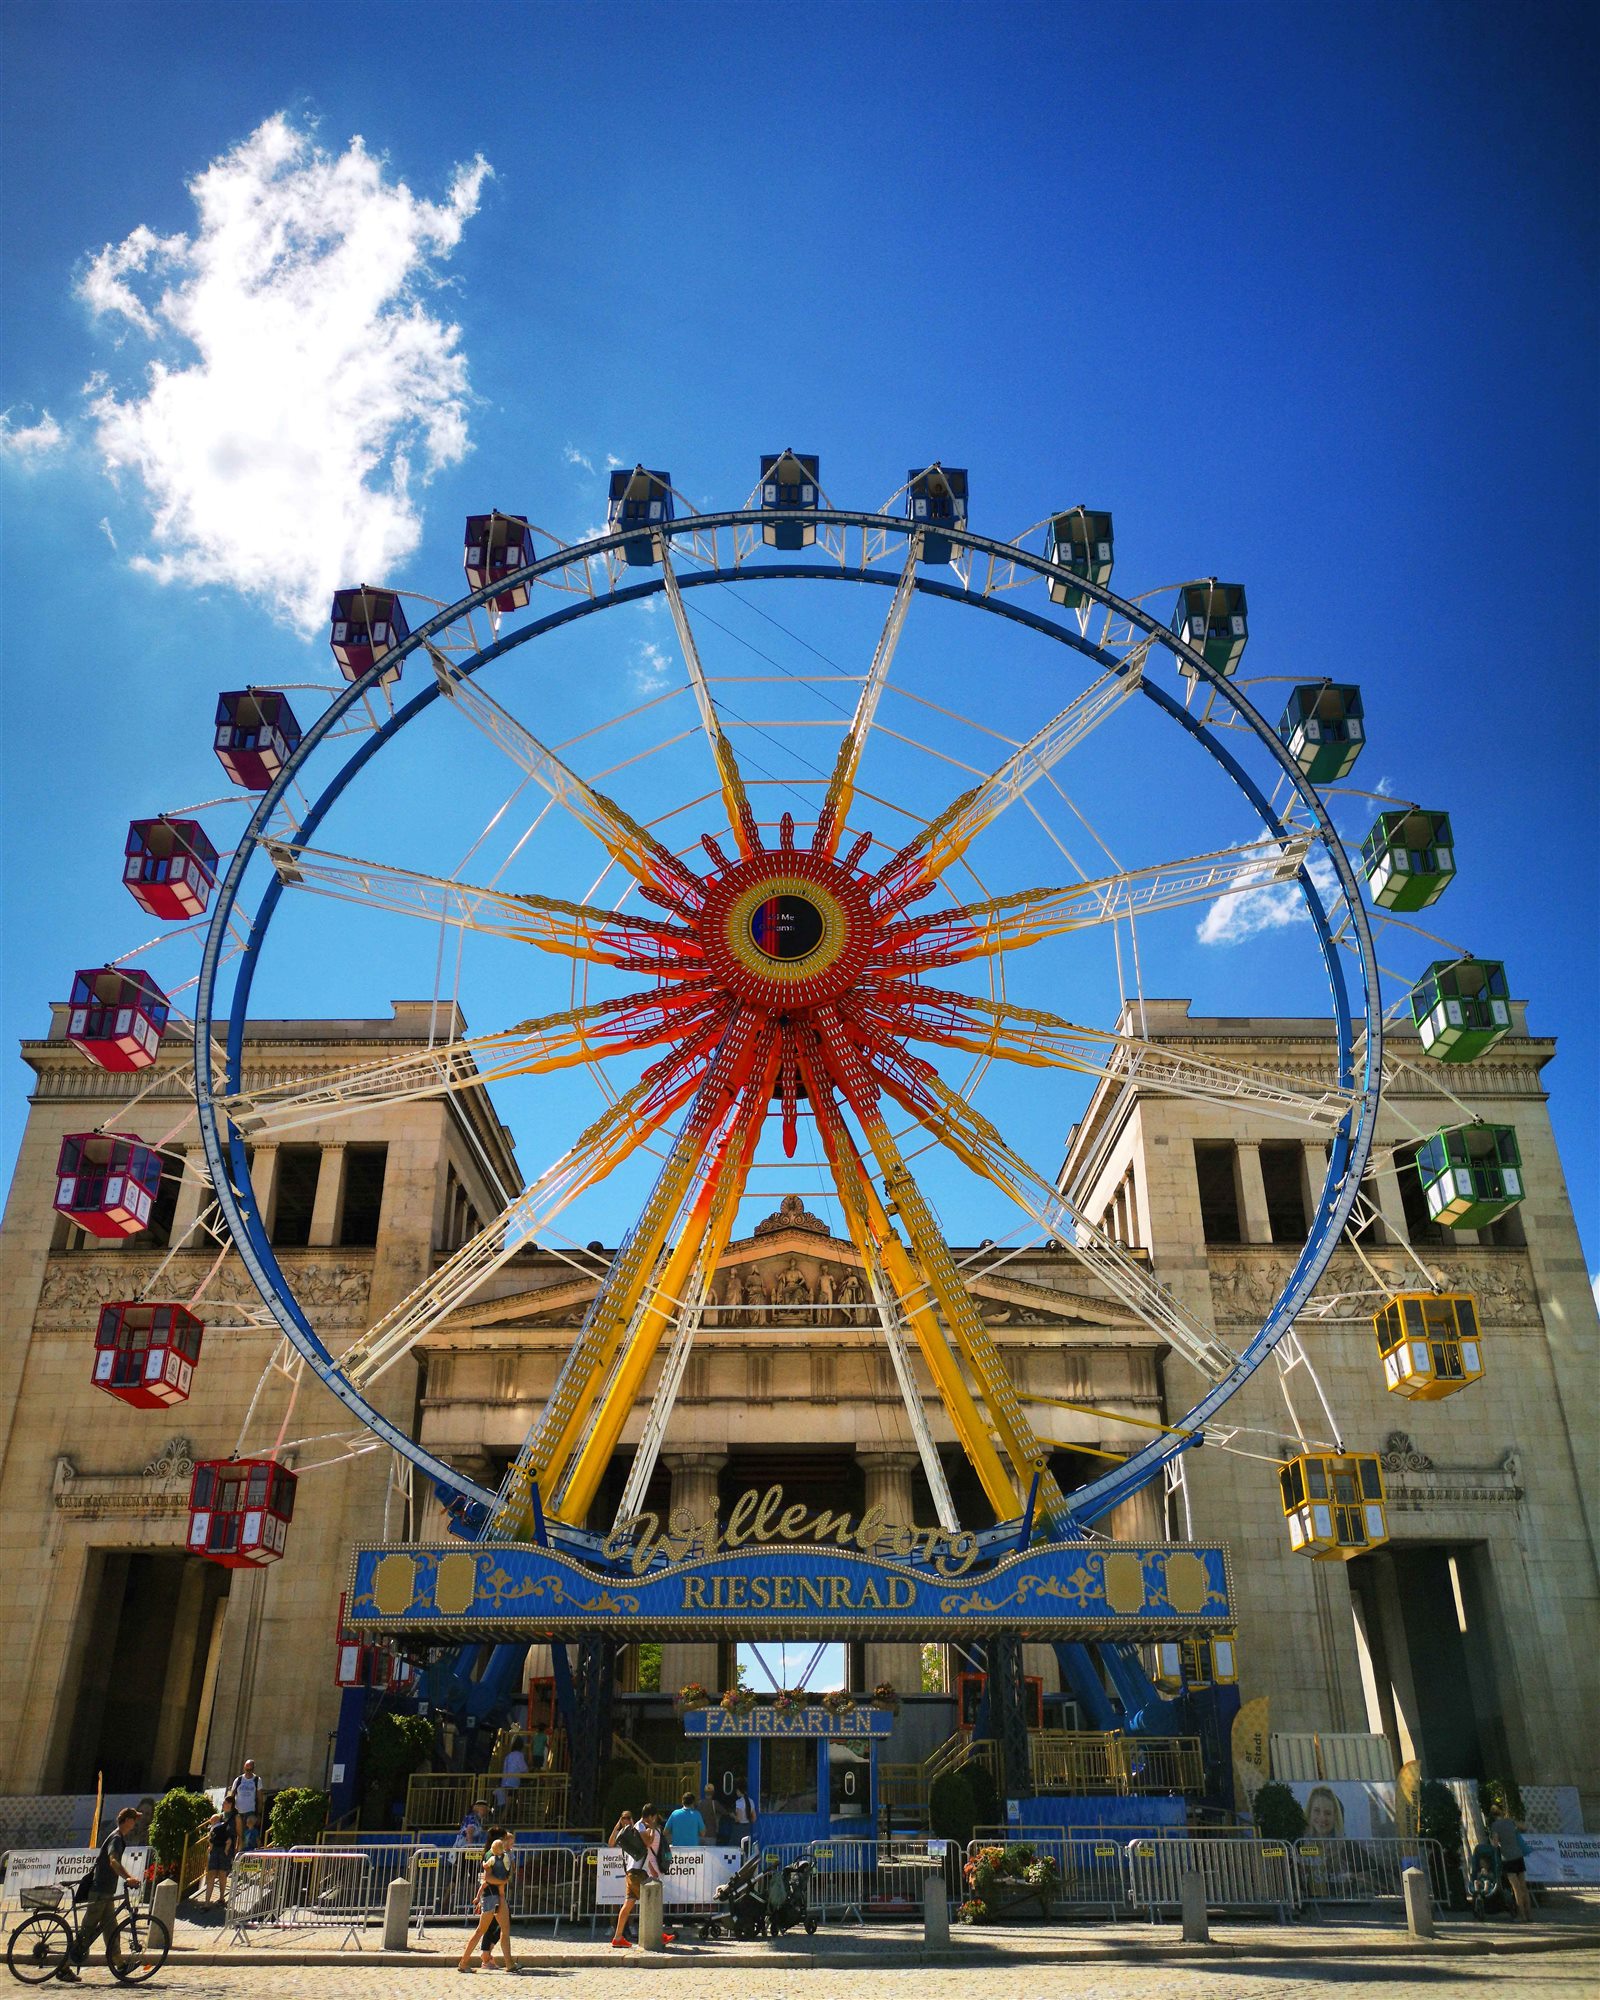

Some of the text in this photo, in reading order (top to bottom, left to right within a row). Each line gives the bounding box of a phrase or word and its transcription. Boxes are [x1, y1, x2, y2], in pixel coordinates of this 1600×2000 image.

[602, 1484, 979, 1576] Willenborg
[681, 1576, 917, 1610] RIESENRAD
[706, 1711, 871, 1732] FAHRKARTEN
[1253, 1732, 1262, 1767] Stadt
[1558, 1839, 1600, 1849] Kunstarea
[670, 1854, 704, 1865] stareal
[1560, 1849, 1600, 1859] München
[56, 1855, 97, 1865] Kunstar
[55, 1865, 95, 1875] Münche
[665, 1865, 695, 1876] chen
